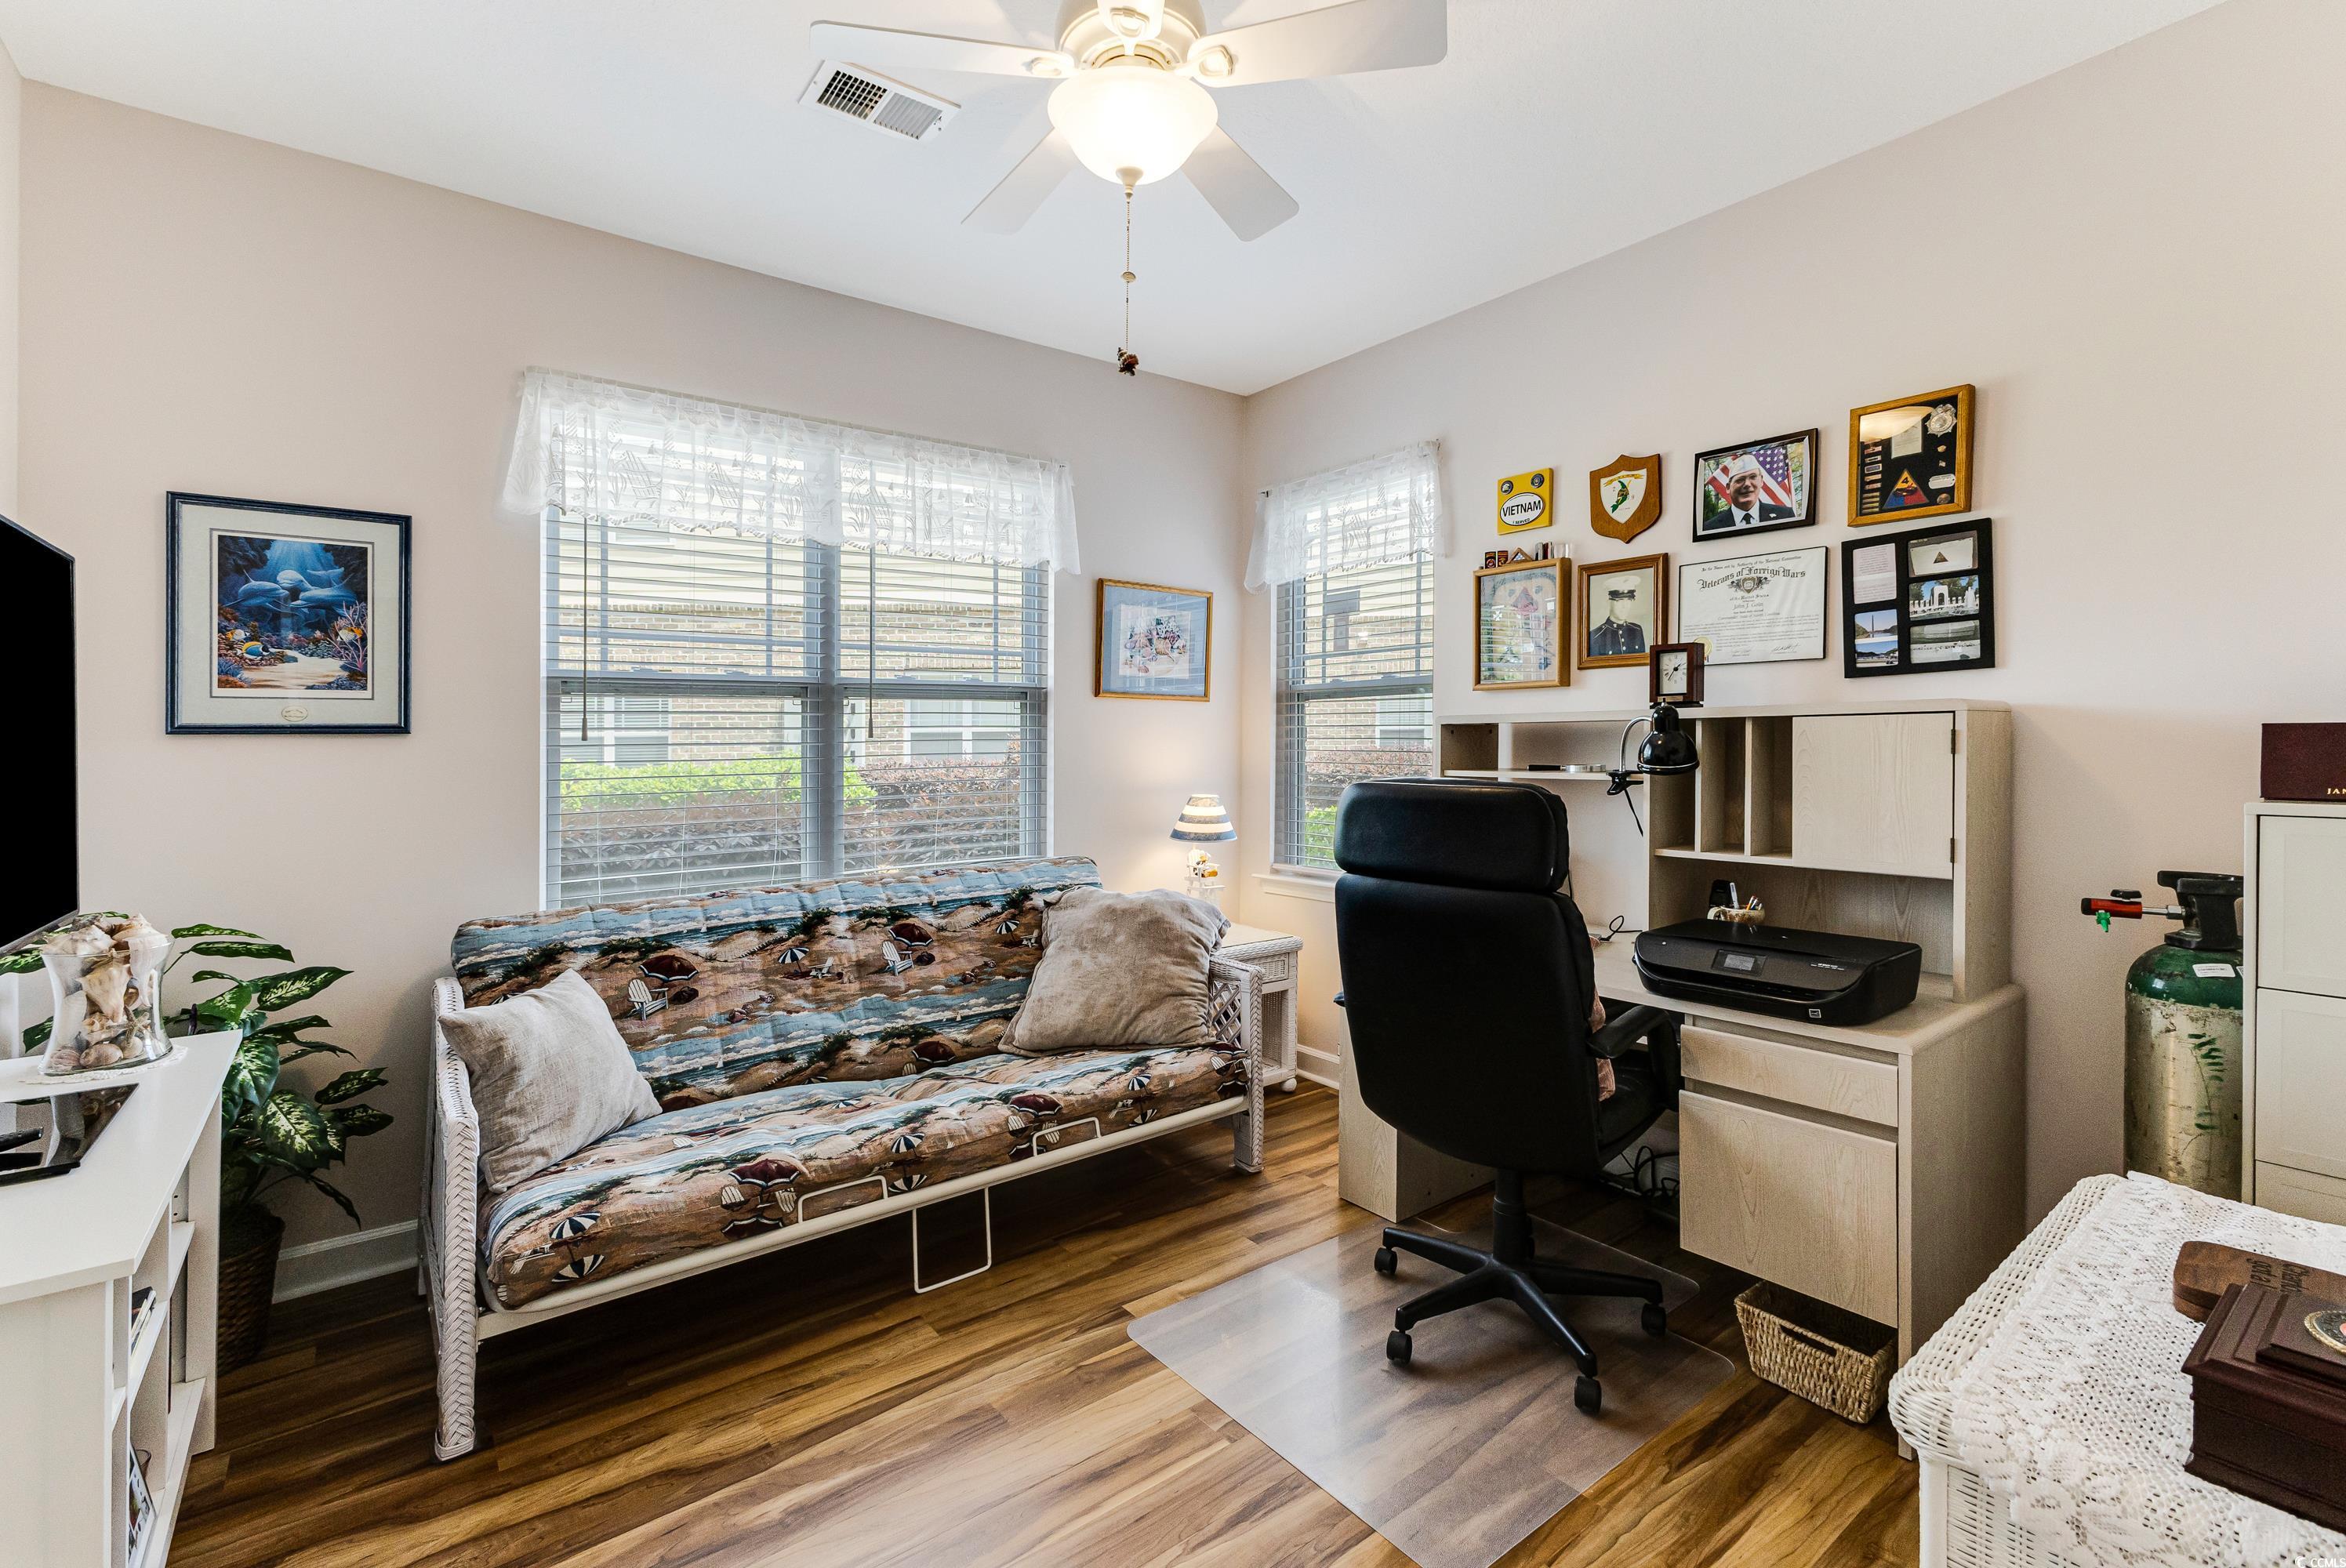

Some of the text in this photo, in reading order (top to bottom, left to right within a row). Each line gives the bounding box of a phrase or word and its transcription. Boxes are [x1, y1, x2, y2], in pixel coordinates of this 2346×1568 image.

[1901, 476, 1909, 485] 4
[1502, 499, 1542, 517] VIETNAM
[1697, 565, 1807, 590] Veterans of Foreign Wars
